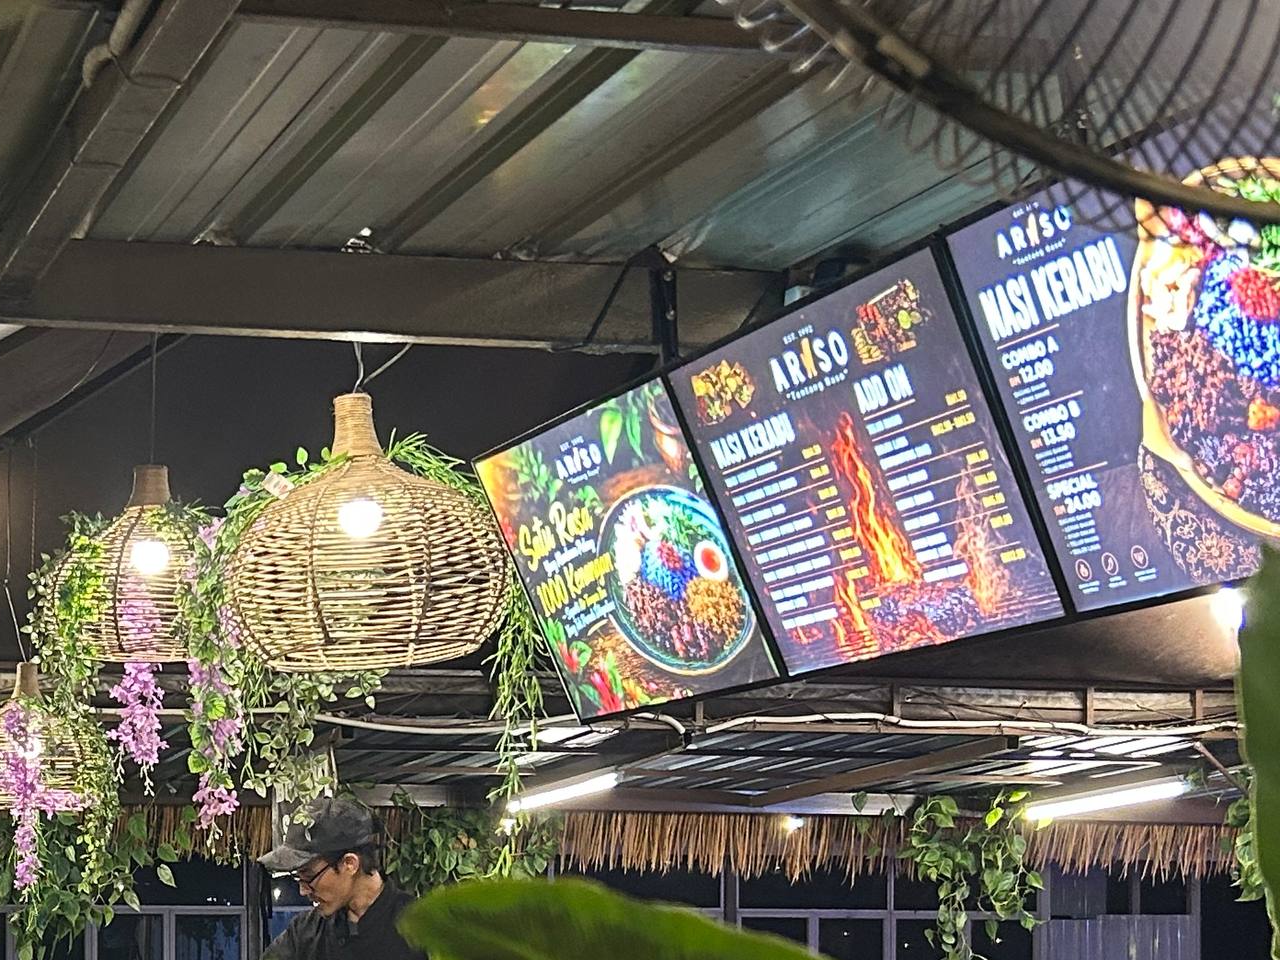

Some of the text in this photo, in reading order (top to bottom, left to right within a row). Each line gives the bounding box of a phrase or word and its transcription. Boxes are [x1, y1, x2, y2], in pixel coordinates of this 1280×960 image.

[979, 236, 1127, 341] NASI KERABU
[770, 330, 848, 393] ARISO
[1002, 335, 1059, 369] COMBO A
[1019, 358, 1053, 383] 12.00
[853, 375, 889, 414] ADD
[884, 363, 914, 401] ON
[710, 412, 795, 469] NASI KERABU
[1023, 404, 1069, 432] COMBO
[519, 516, 556, 572] Satu
[549, 501, 593, 546] Rasa
[537, 574, 569, 617] 1000
